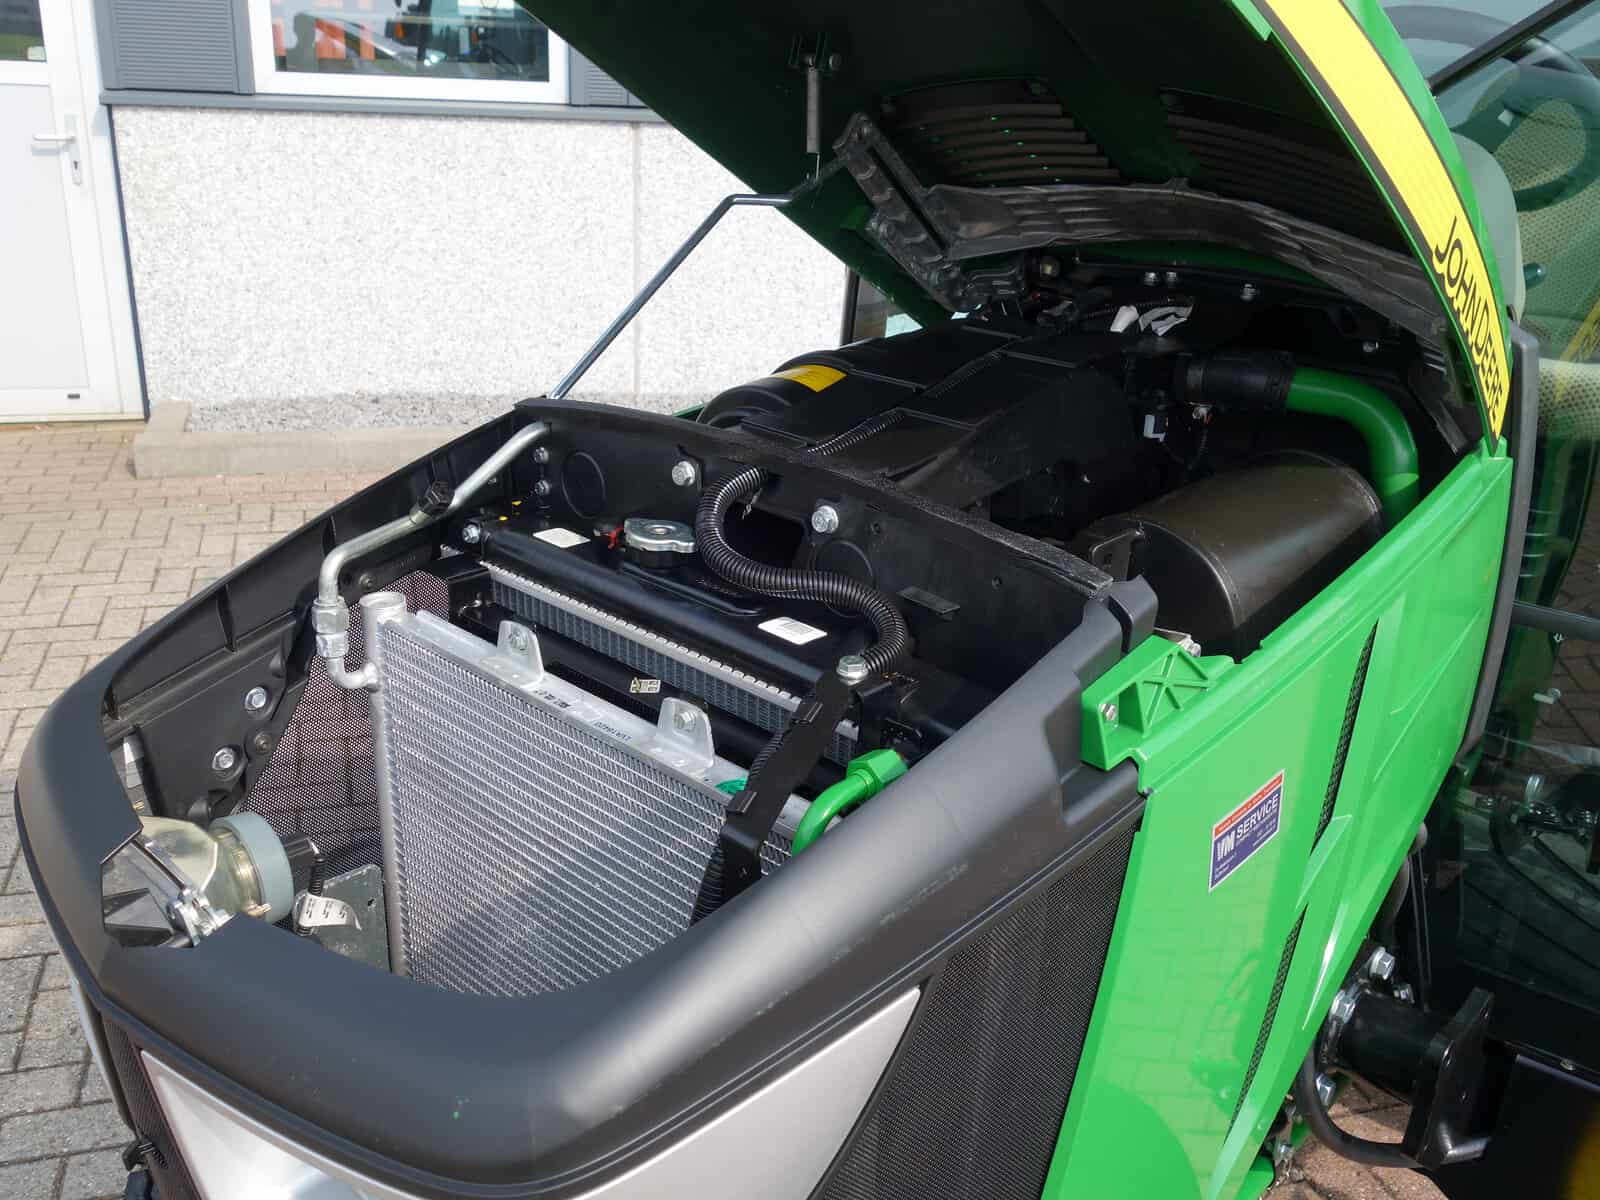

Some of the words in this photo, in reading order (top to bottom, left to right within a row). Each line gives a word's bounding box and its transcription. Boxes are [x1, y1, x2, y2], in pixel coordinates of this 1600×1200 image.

[1435, 216, 1482, 334] JOHN
[1475, 301, 1503, 420] DEERE
[1237, 793, 1279, 839] SERVICE
